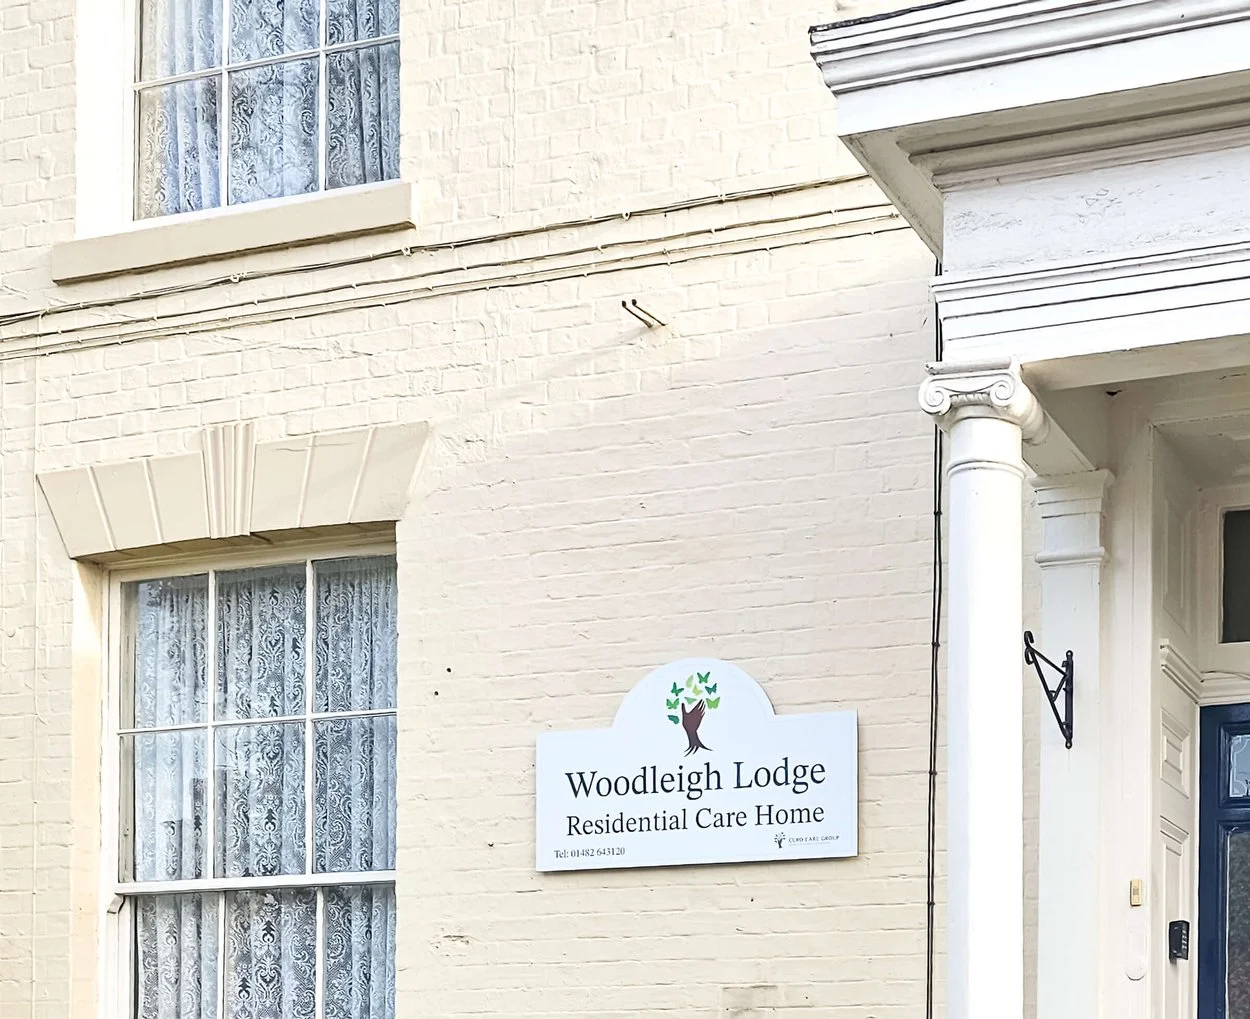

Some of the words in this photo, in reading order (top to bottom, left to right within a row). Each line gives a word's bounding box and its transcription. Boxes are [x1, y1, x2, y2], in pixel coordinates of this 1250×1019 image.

[565, 762, 723, 800] Woodleigh
[733, 757, 826, 794] Lodge
[566, 806, 688, 836] Residential
[695, 807, 747, 829] Care
[754, 804, 825, 826] Home
[554, 849, 569, 859] Tel:
[570, 848, 595, 858] 01482
